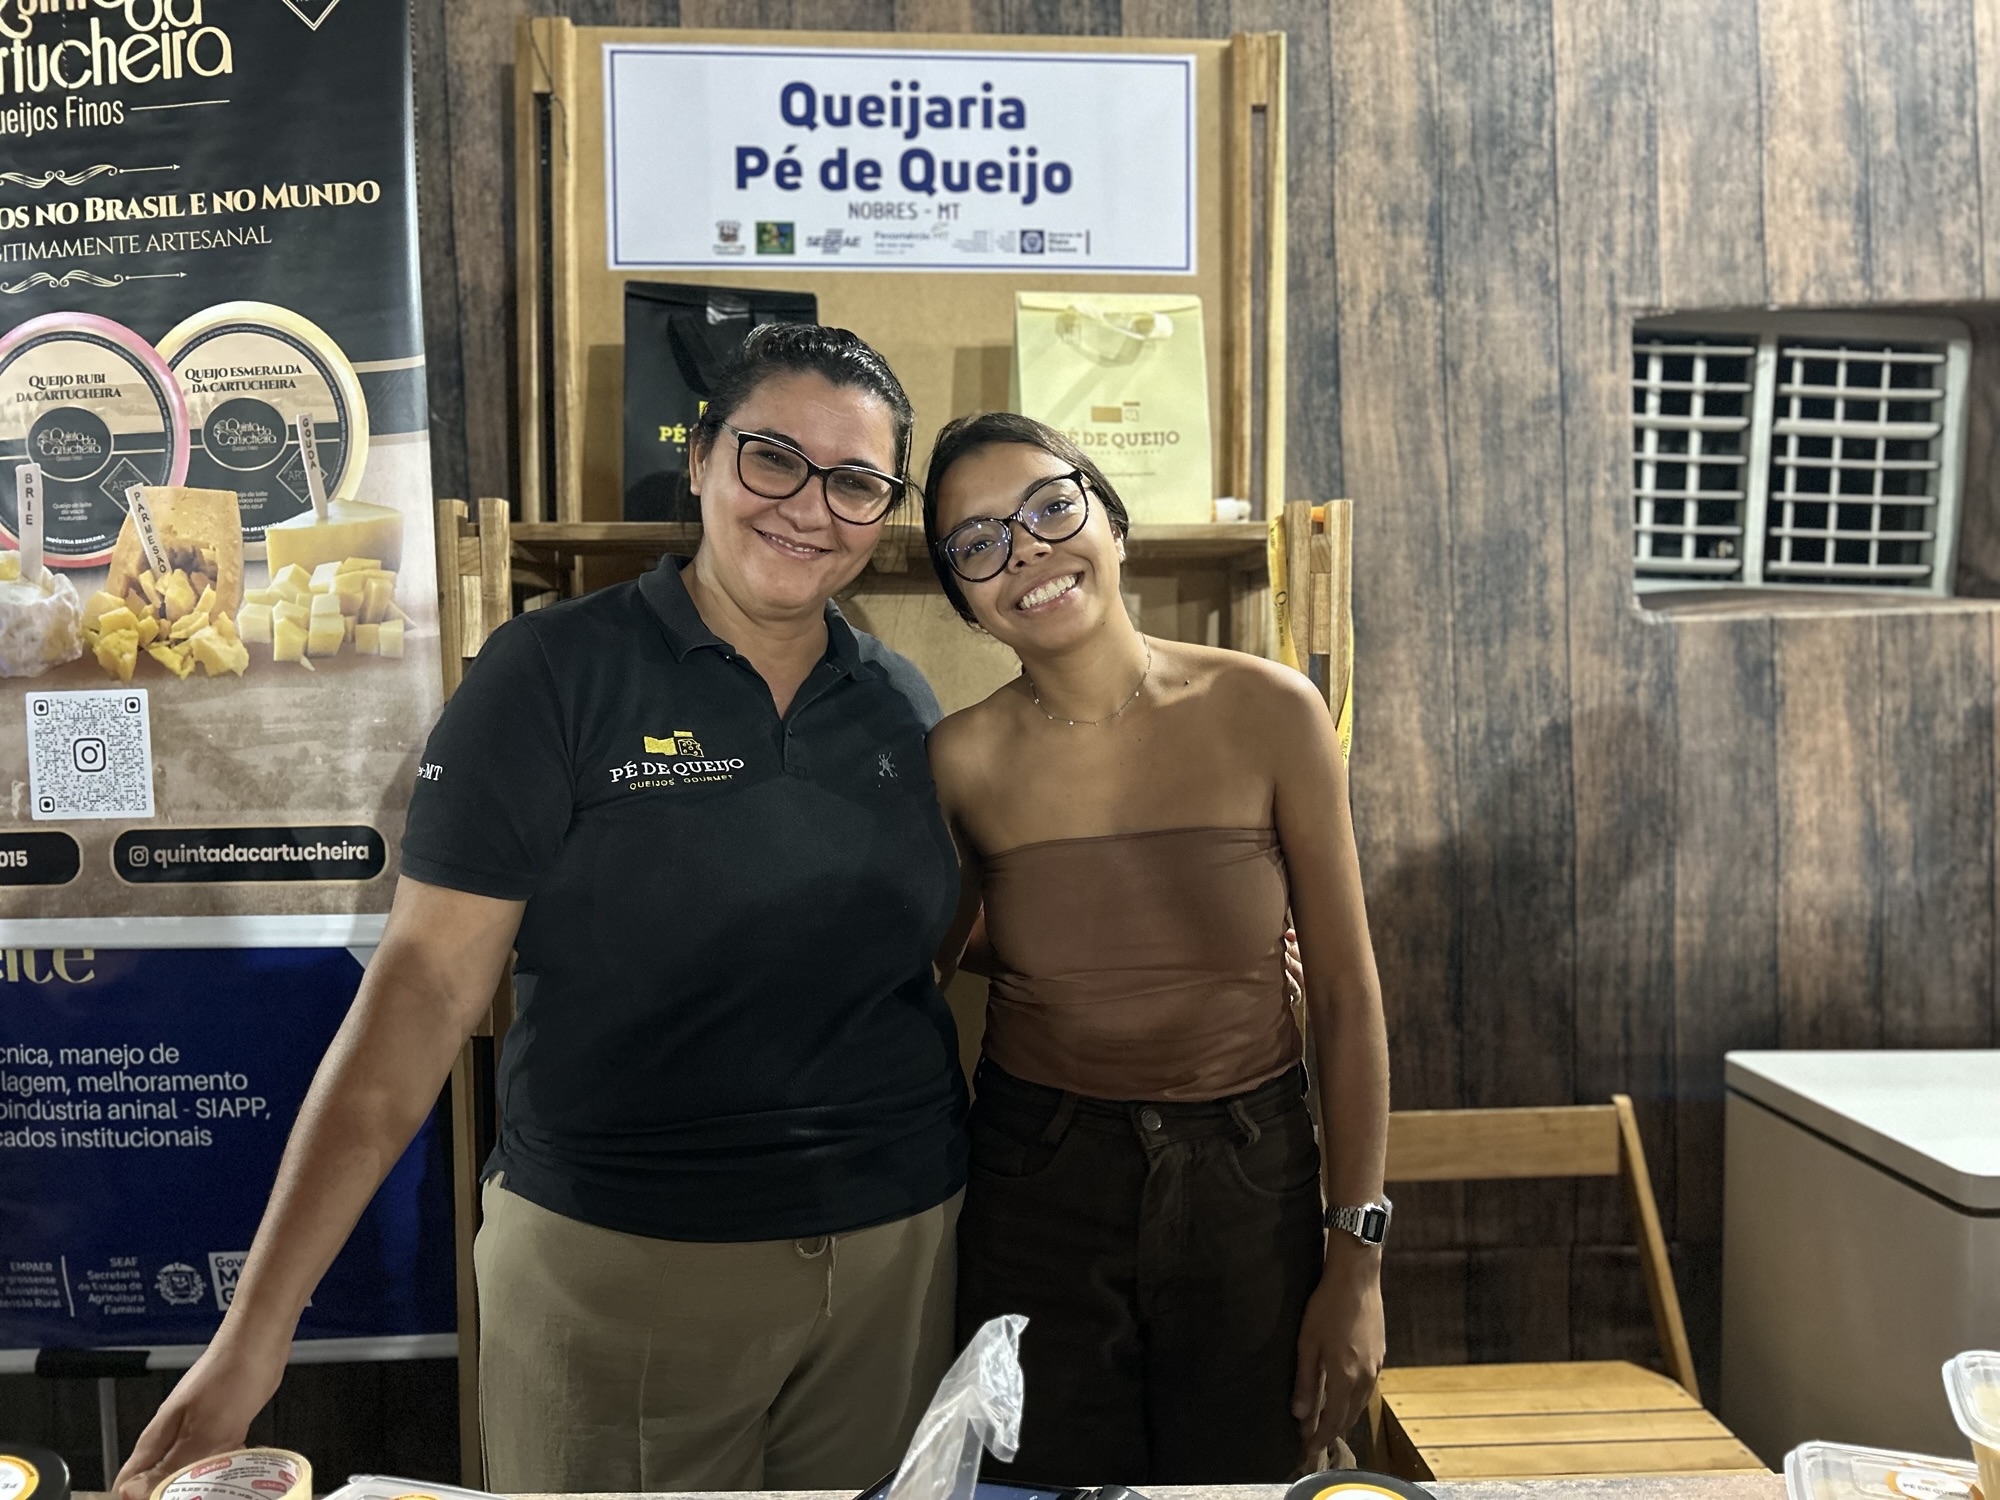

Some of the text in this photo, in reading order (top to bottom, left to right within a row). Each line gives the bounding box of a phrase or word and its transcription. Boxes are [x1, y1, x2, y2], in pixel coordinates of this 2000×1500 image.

[66, 95, 124, 128] Finos
[779, 80, 1026, 139] Queijaria
[735, 145, 1073, 205] Pé de Queijo
[35, 202, 79, 226] NO
[84, 194, 186, 223] BRASIL
[189, 192, 208, 216] E
[212, 188, 257, 214] NO
[260, 180, 381, 210] MUNDO
[848, 202, 918, 220] NOBRES
[937, 203, 961, 220] MT
[0, 225, 273, 262] ITIMAMENTE ARTESANAL
[29, 373, 106, 388] QUEIJO RUBI
[185, 364, 302, 382] QUEIJO ESMERALDA
[16, 388, 122, 403] DA CARTUCHEIRA
[192, 379, 296, 393] DA CARTUCHEIRA
[659, 423, 687, 443] PÉ
[1083, 432, 1108, 446] DE
[1111, 430, 1180, 450] QUEIJO
[25, 473, 34, 525] BRIE
[609, 758, 744, 783] PÉ DE QUEIJO
[629, 774, 734, 791] QUEIJOS GOURMET
[154, 840, 370, 869] quintadacartucheira
[60, 1044, 144, 1070] manejo
[150, 1043, 180, 1064] de
[1, 1070, 248, 1097] lagem, melhoramento
[108, 1098, 178, 1120] aninal
[195, 1097, 271, 1120] SIAPP,
[61, 1126, 213, 1149] institucionais
[109, 1256, 138, 1268] SEAF
